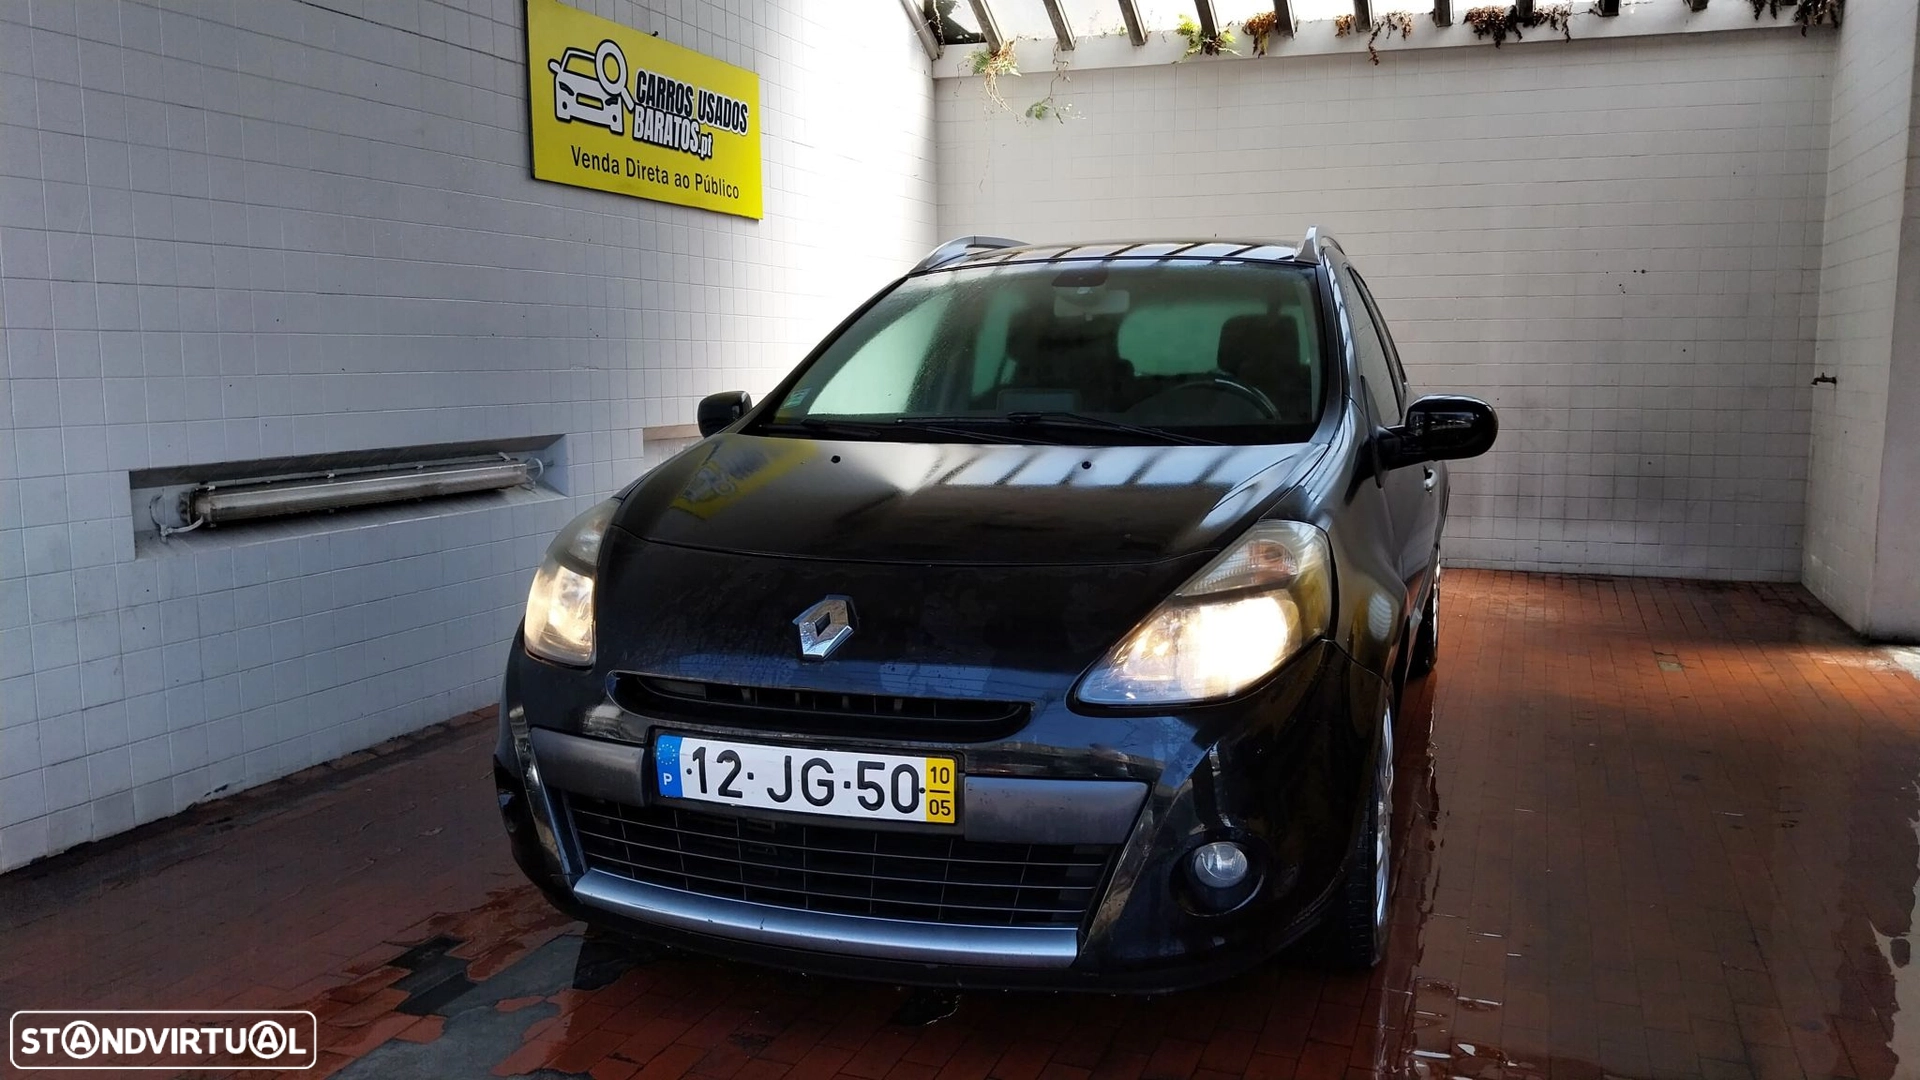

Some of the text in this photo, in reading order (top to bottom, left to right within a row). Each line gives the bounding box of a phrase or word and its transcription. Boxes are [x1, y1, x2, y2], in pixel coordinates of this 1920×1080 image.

[637, 70, 749, 134] CARROS USADOS
[571, 146, 740, 199] Venda Direta ao Público
[663, 772, 673, 786] P
[930, 766, 950, 785] 10
[929, 799, 951, 816] 05
